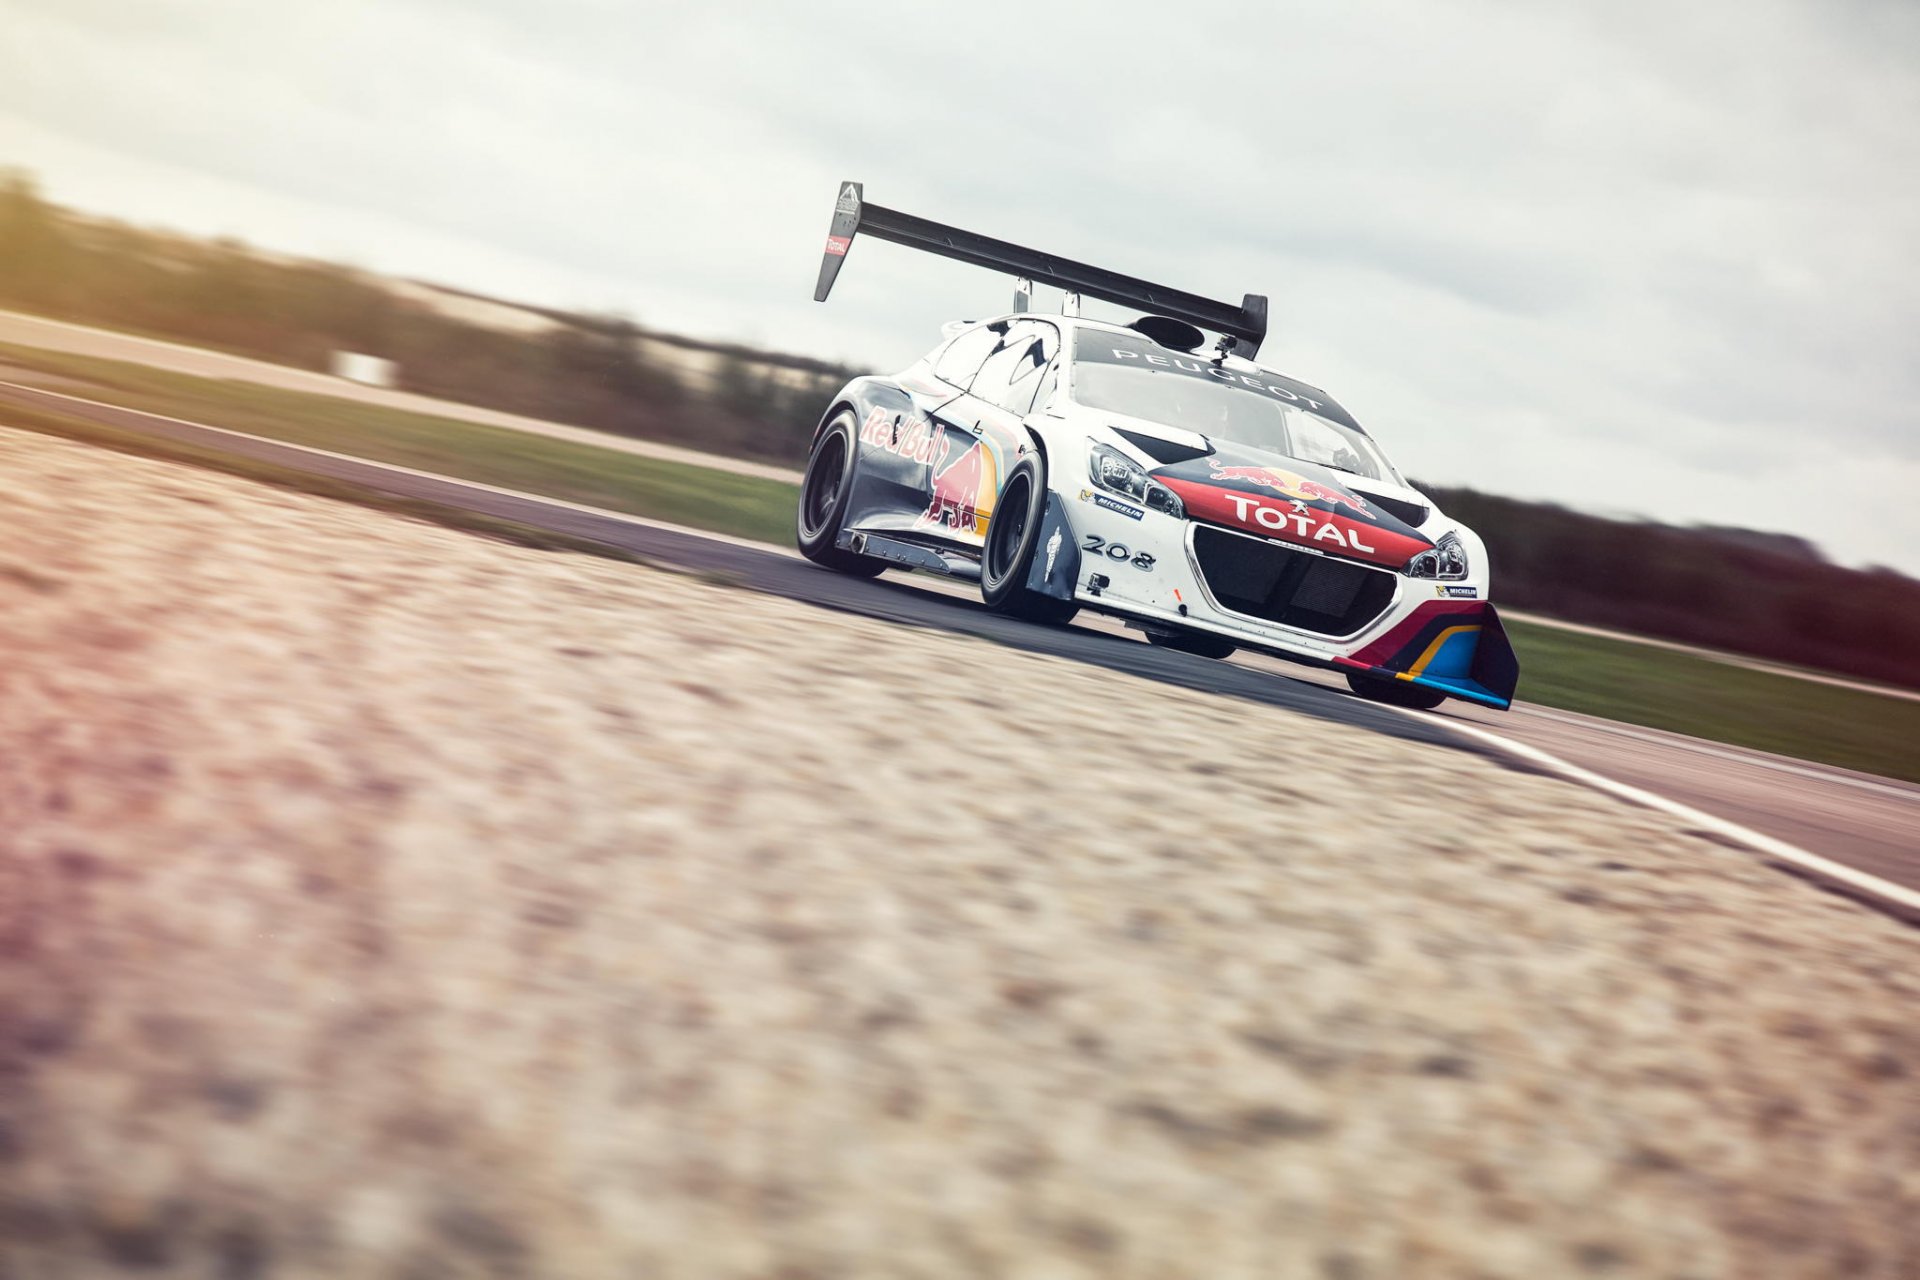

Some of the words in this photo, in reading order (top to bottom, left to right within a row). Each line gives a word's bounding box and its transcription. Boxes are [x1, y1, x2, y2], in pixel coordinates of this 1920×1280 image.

[1111, 348, 1324, 410] PEUGEOT
[859, 404, 915, 455] Red
[898, 420, 945, 467] Bull
[1098, 496, 1143, 518] MICHELIN
[1224, 494, 1375, 554] TOTAL
[1082, 533, 1157, 573] 208
